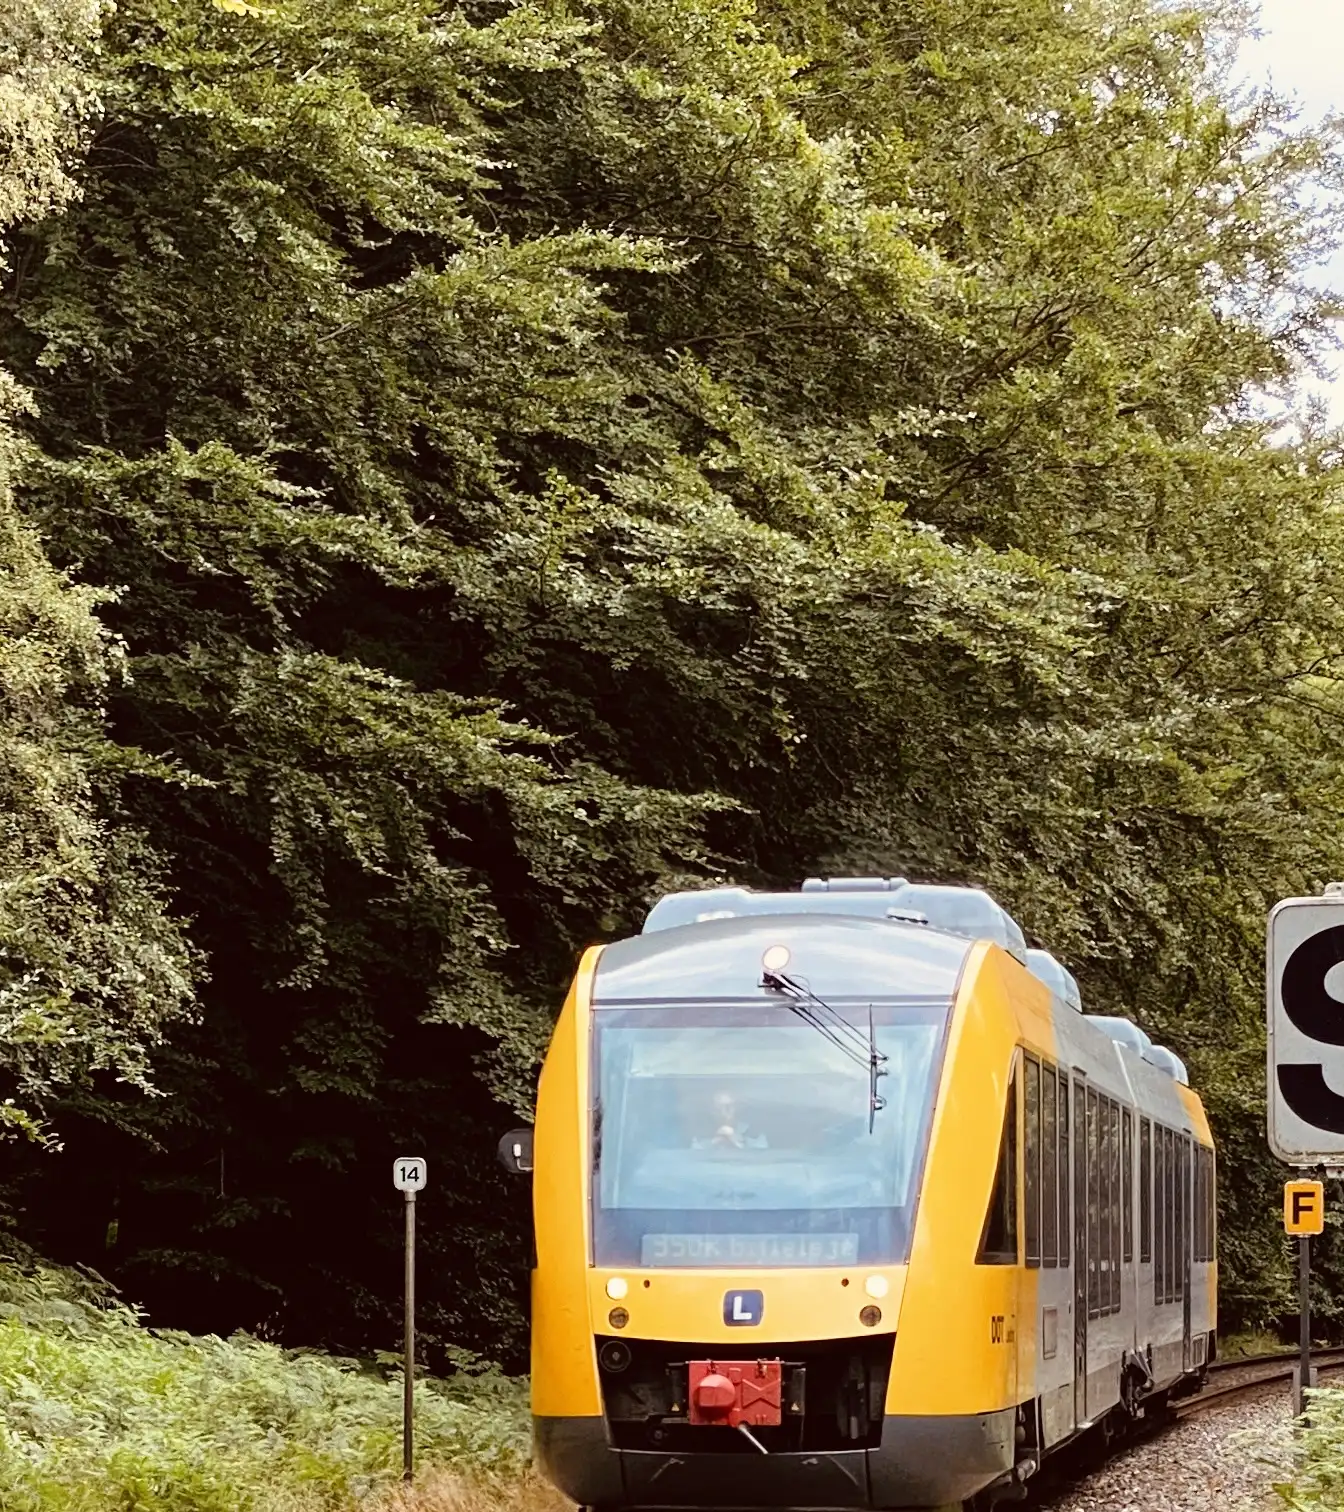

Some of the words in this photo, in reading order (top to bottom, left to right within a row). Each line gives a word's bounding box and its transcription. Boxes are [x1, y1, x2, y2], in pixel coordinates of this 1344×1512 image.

[400, 1166, 419, 1182] 14
[1293, 1192, 1315, 1225] F
[733, 1296, 752, 1320] L
